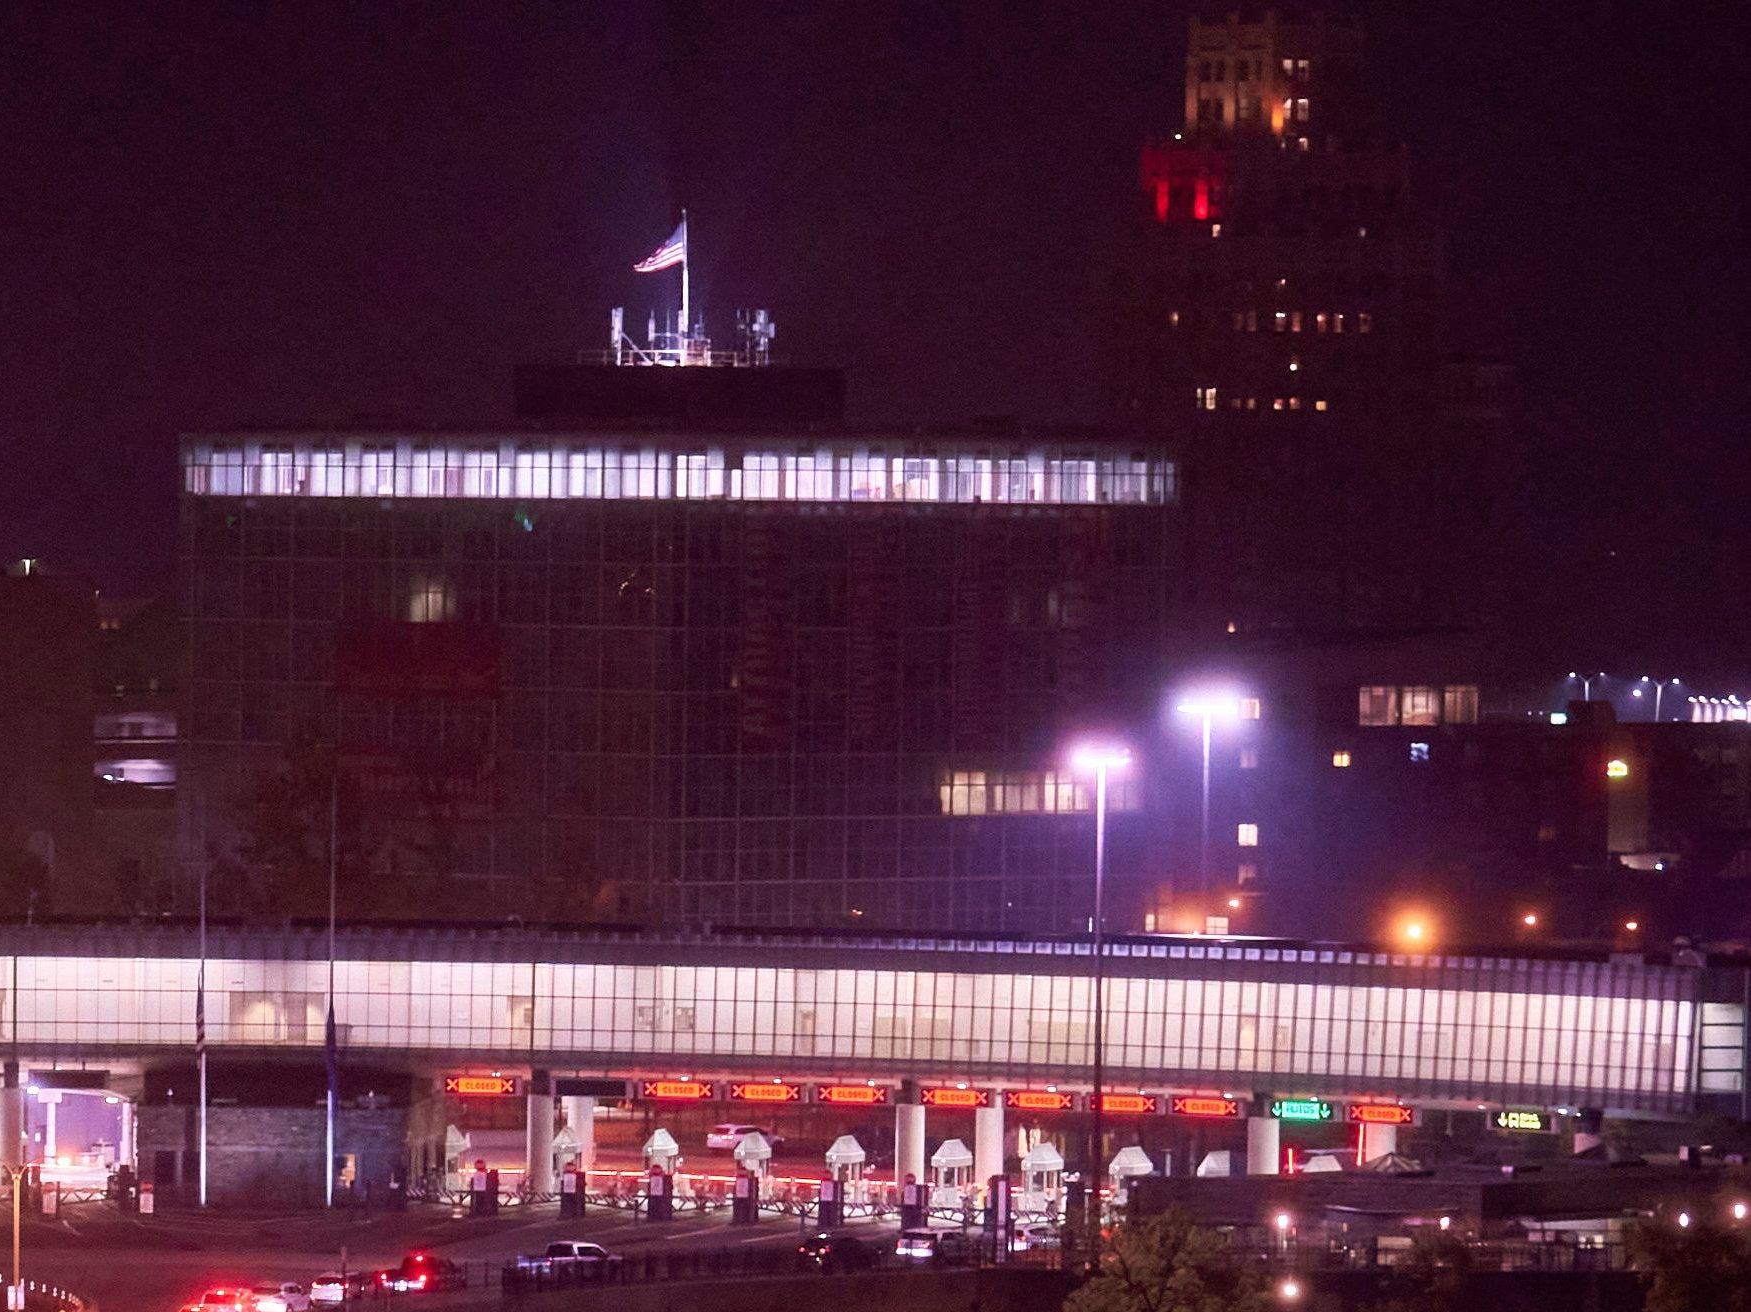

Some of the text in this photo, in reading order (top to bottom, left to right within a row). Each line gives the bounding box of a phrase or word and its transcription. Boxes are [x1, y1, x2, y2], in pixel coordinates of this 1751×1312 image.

[465, 1080, 496, 1090] CLOSED
[662, 1086, 694, 1096] CLOSED
[750, 1087, 782, 1097] CLOSED
[838, 1090, 868, 1099] CLOSED
[940, 1092, 971, 1102] CLOSED
[1025, 1095, 1056, 1105] CLOSED
